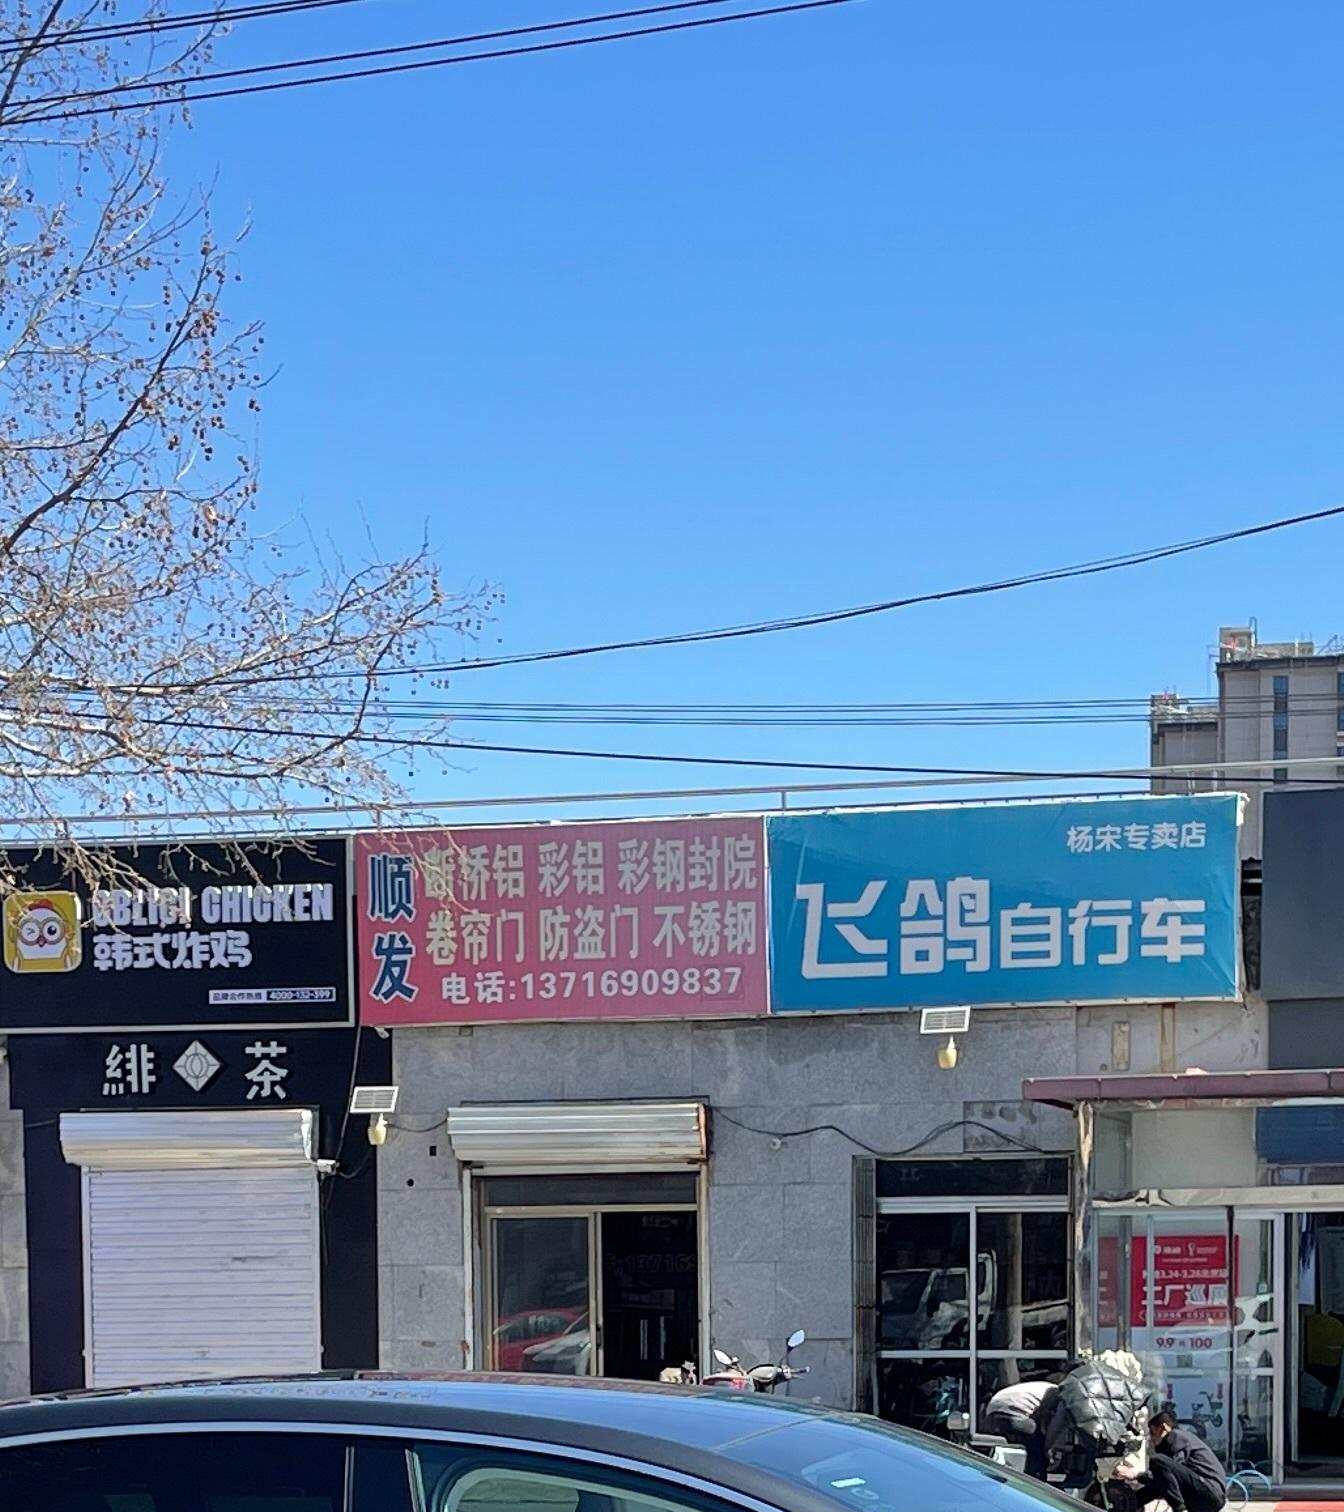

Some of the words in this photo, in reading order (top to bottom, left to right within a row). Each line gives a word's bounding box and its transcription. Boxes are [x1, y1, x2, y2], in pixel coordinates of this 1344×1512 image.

[424, 843, 526, 901] 断桥铝
[538, 839, 605, 898] 彩铝
[618, 833, 758, 895] 彩钢封院
[1066, 820, 1206, 854] 杨宋专卖店
[201, 883, 334, 924] CHICKEN
[367, 851, 418, 1004] 顺发
[425, 908, 526, 966] 卷帘门
[539, 904, 640, 962] 防盗门
[652, 900, 758, 958] 不锈钢
[795, 876, 1206, 980] 飞鸽自行车
[93, 930, 253, 971] 韩式炸鸡
[244, 1041, 289, 1100] 茶
